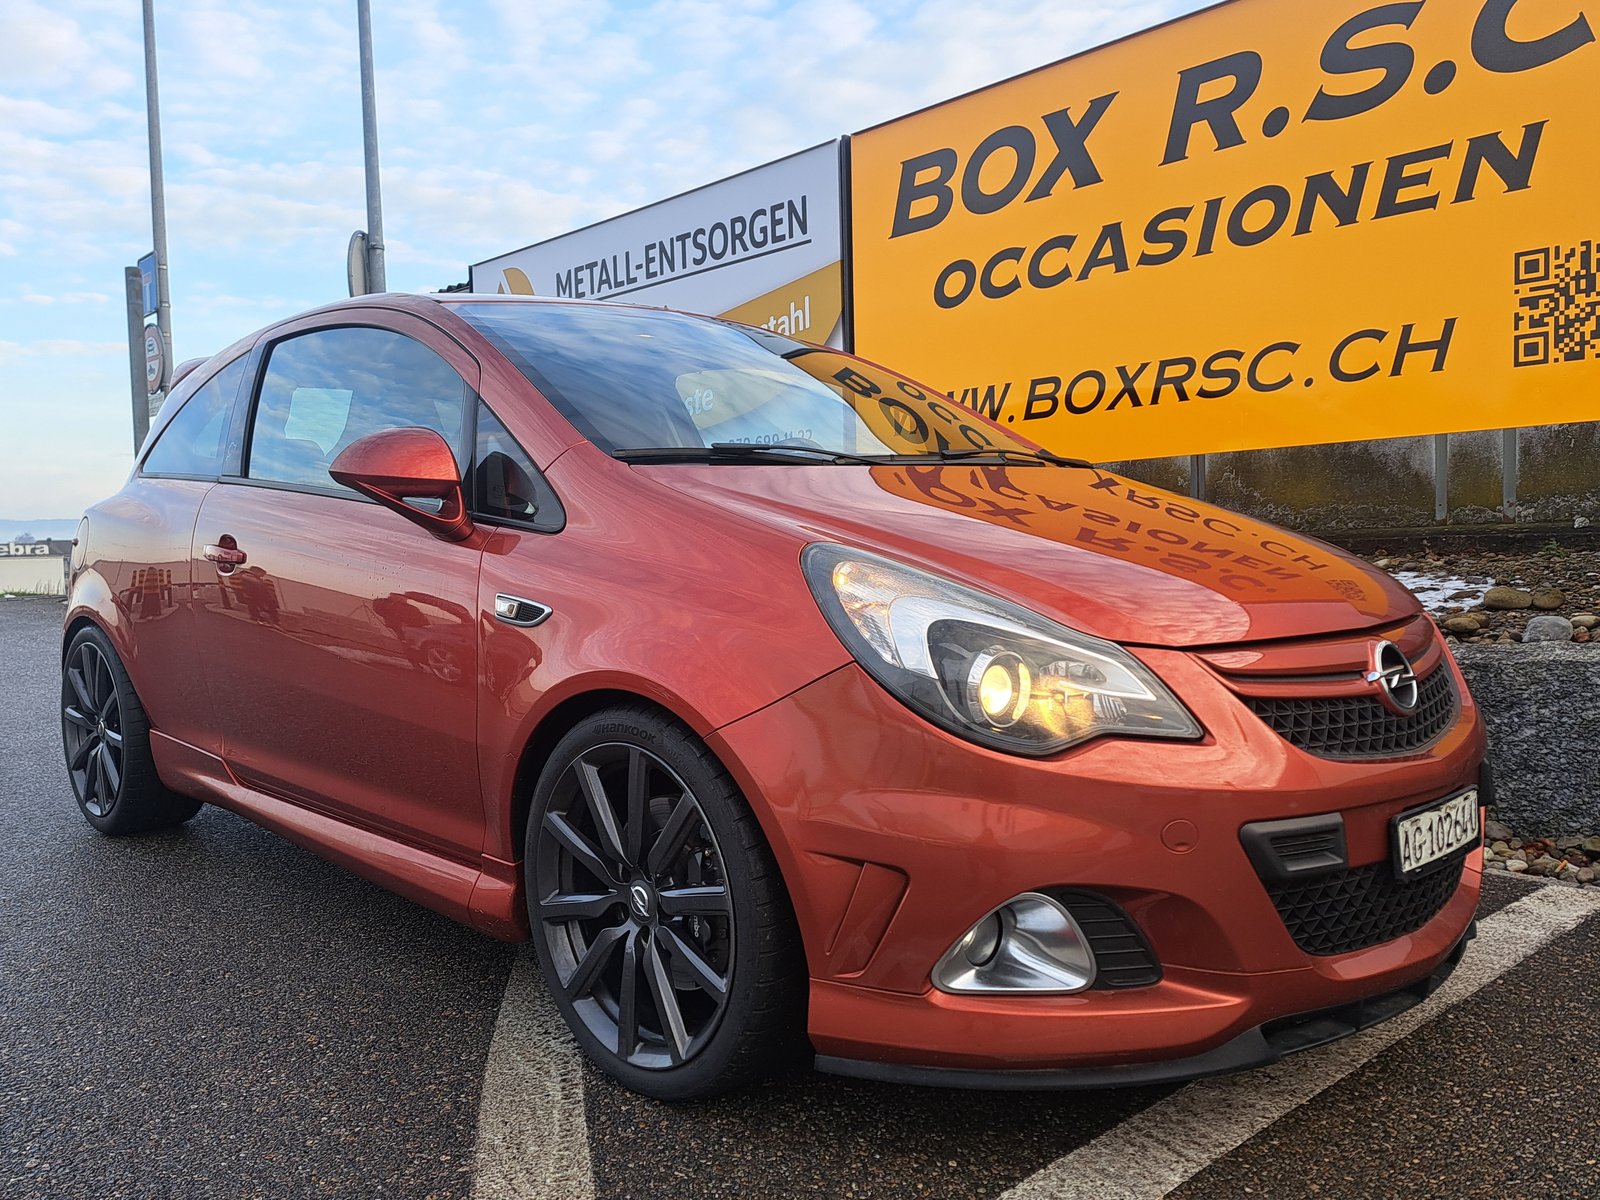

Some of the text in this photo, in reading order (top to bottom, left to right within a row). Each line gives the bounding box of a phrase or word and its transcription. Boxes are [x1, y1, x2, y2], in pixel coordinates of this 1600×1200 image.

[887, 90, 1120, 240] BOX
[933, 119, 1550, 309] OCCASIONEN
[555, 194, 809, 299] METALL-ENTSORGEN
